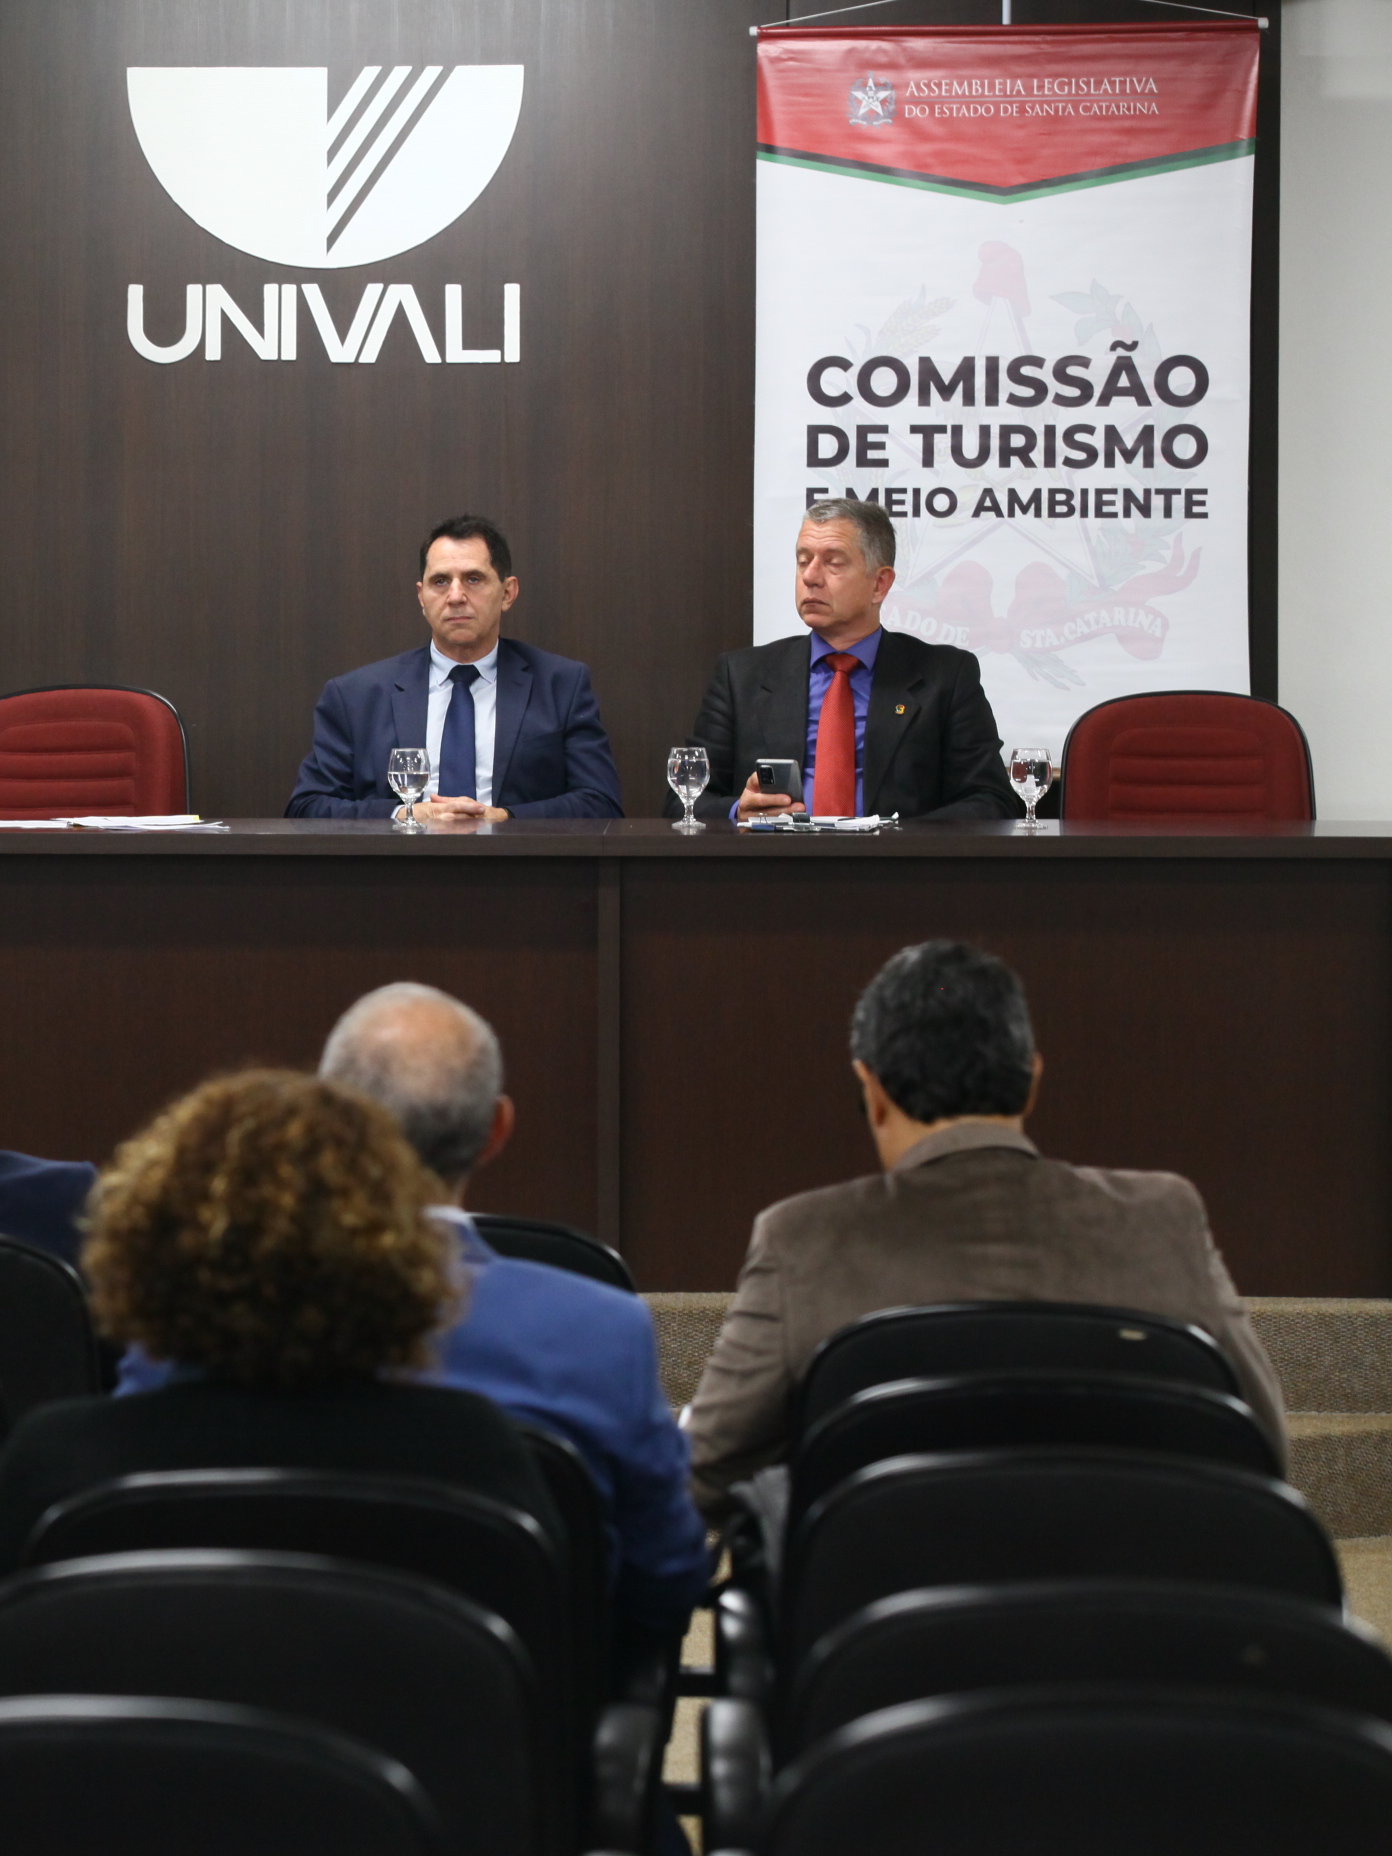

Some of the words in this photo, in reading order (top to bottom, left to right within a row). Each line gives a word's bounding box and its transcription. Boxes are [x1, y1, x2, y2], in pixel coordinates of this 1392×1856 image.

[906, 79, 1026, 97] ASSEMBLEIA
[1033, 77, 1158, 95] LEGISLATIVA
[905, 104, 929, 118] DO
[935, 104, 994, 117] ESTADO
[1000, 103, 1019, 117] DE
[1025, 102, 1075, 116] SANTA
[1079, 101, 1159, 116] CATARINA
[127, 283, 520, 363] UNIVALI
[807, 340, 1209, 408] COMISSÃO
[807, 424, 889, 469] DE
[910, 424, 1208, 469] TURISMO
[971, 487, 1208, 519] AMBIENTE
[936, 623, 970, 647] DE
